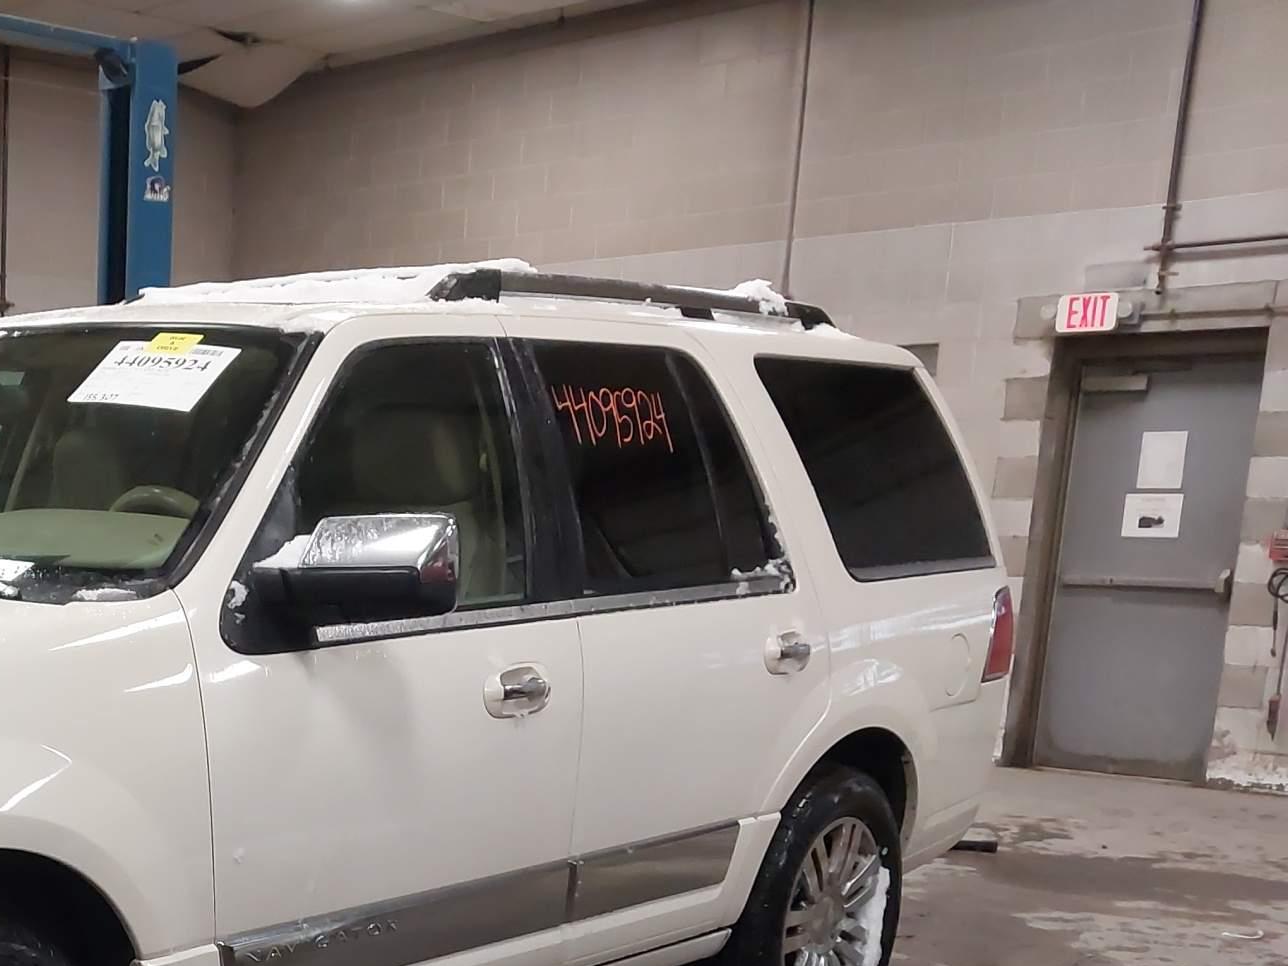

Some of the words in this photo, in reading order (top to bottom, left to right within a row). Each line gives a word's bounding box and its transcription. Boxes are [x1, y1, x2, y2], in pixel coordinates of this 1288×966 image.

[1066, 295, 1111, 329] EXIT
[113, 355, 212, 372] 44095924
[551, 384, 674, 454] 44095924
[244, 919, 399, 963] NAVGATOR
